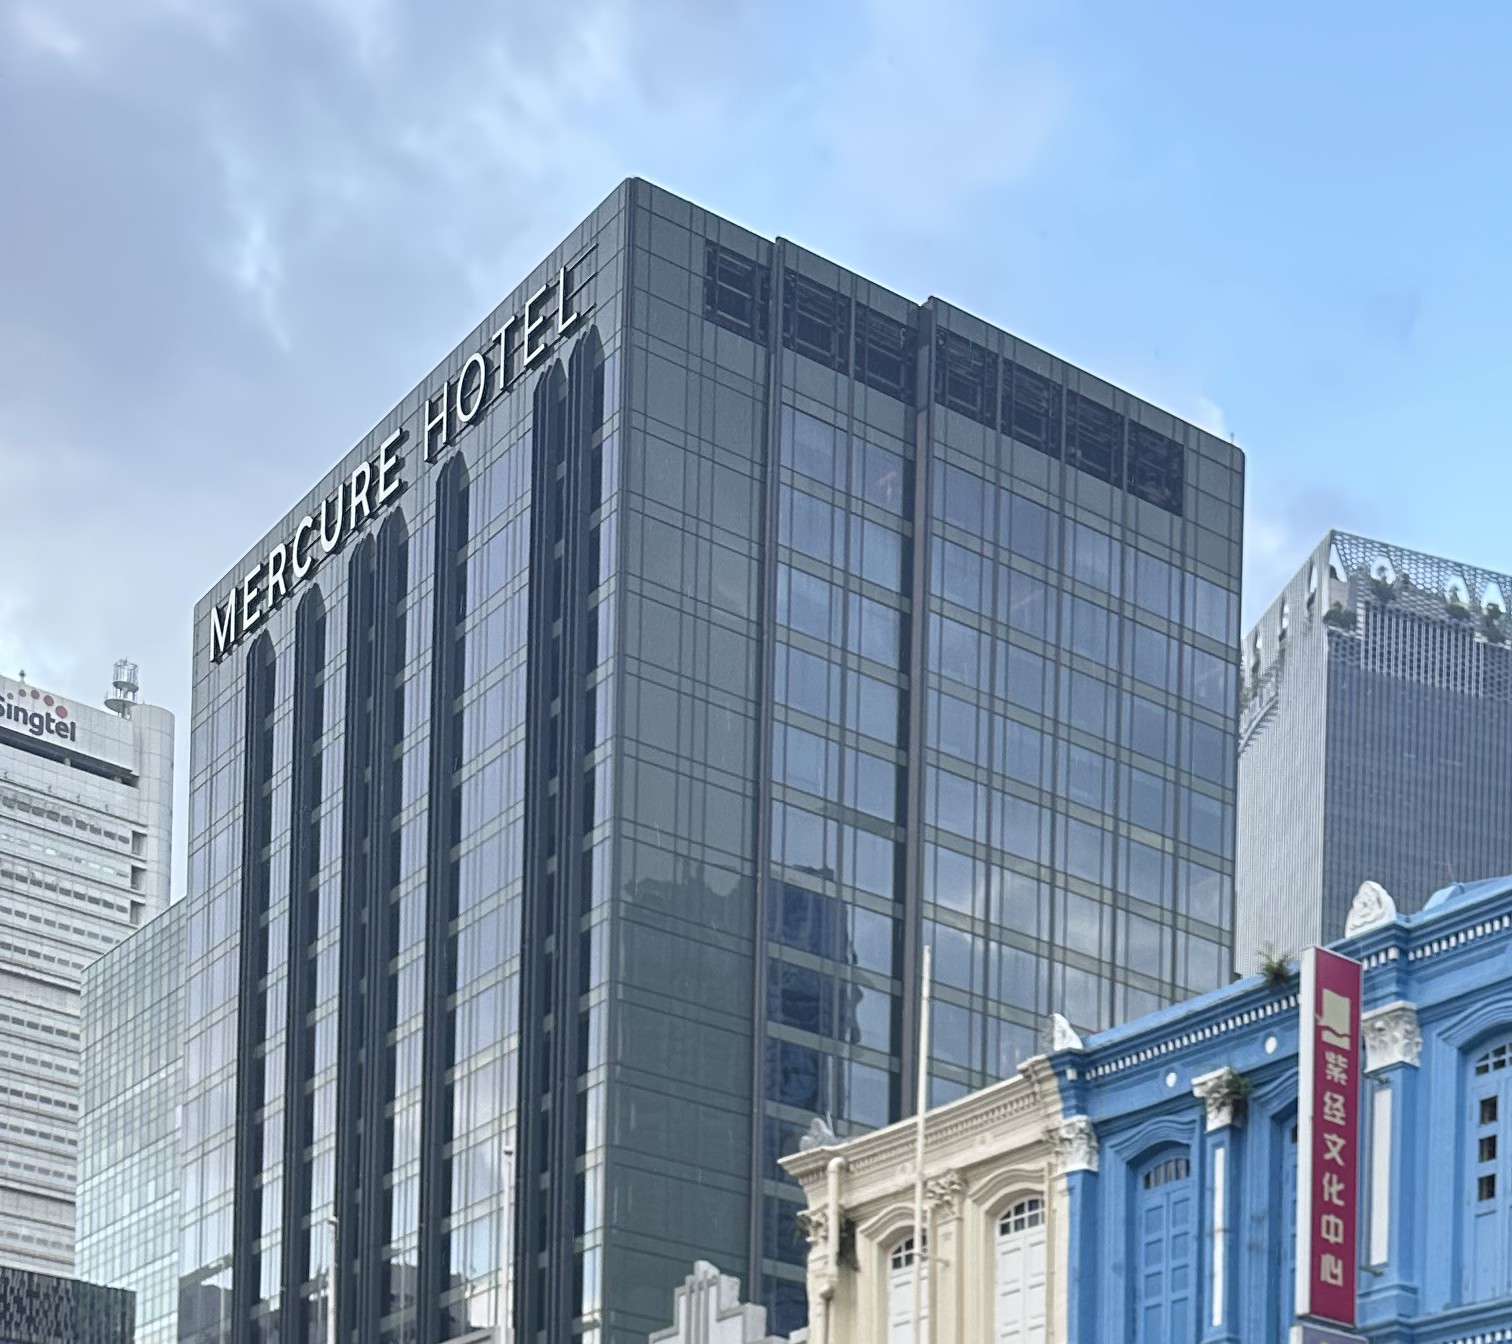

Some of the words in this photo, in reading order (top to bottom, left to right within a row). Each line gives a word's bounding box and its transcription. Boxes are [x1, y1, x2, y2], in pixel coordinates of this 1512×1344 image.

[209, 428, 404, 664] MERCURE
[424, 265, 580, 462] HOTEL
[1319, 1050, 1350, 1288] 紫经文化中心
